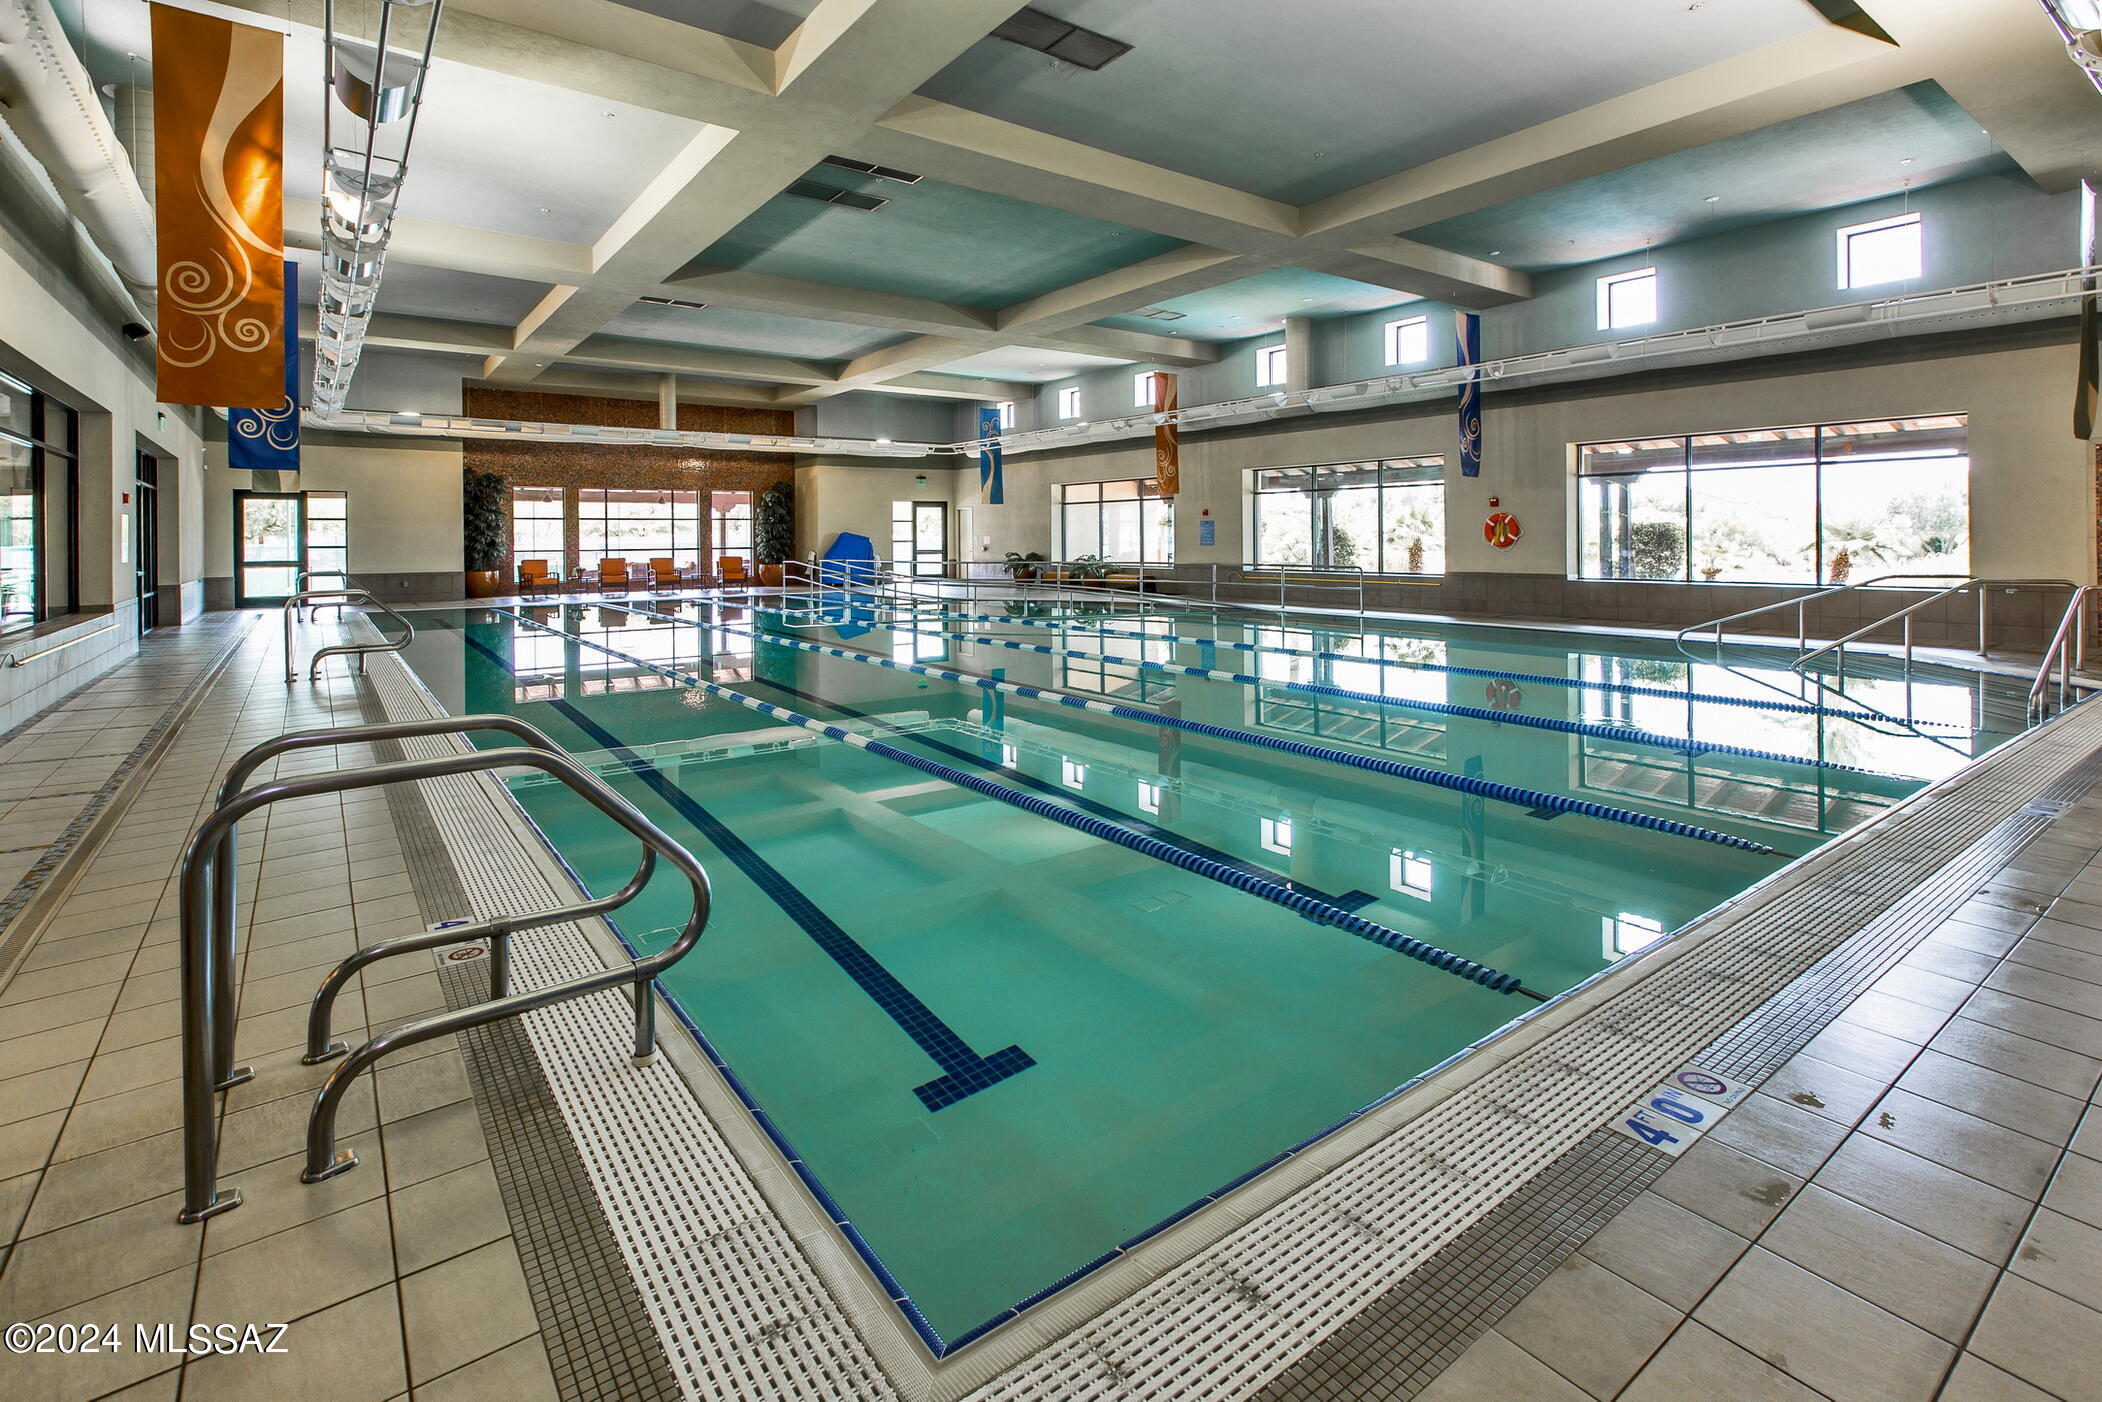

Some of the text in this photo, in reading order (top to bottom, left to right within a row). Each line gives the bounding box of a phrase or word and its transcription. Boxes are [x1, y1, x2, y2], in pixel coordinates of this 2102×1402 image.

[434, 920, 469, 930] 4
[1650, 1097, 1704, 1124] 0
[1625, 1118, 1680, 1145] 4
